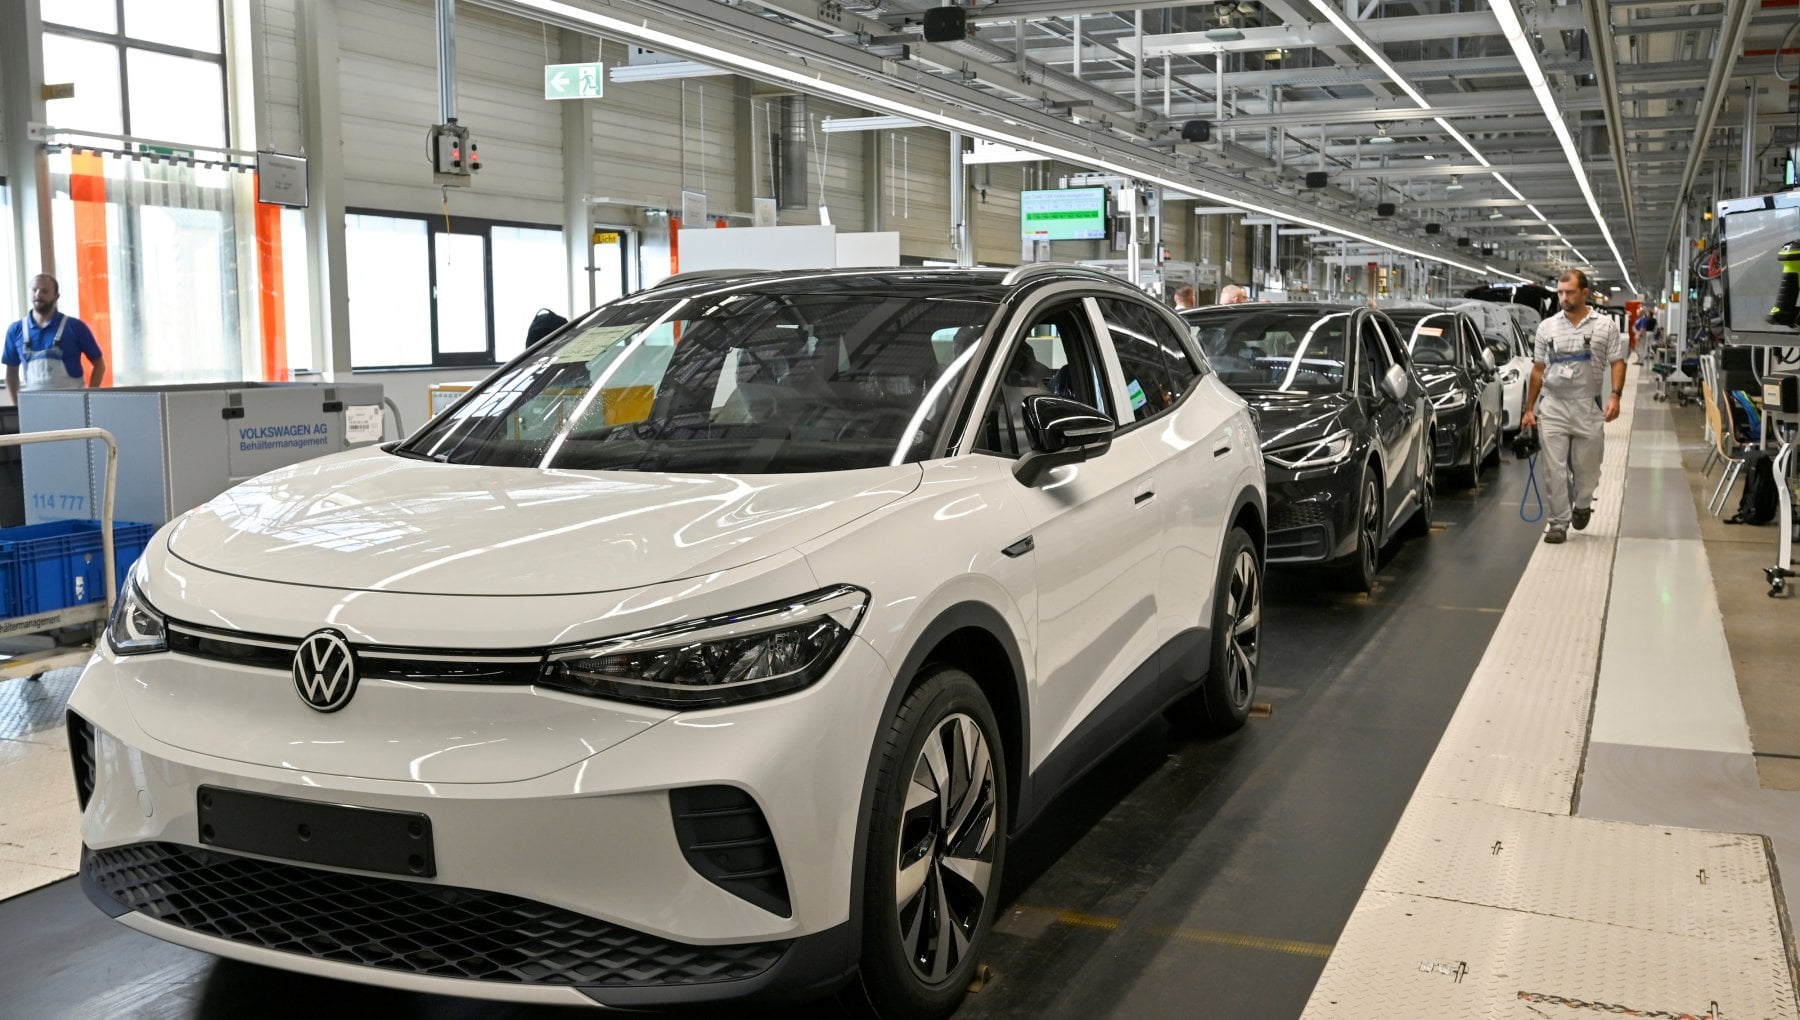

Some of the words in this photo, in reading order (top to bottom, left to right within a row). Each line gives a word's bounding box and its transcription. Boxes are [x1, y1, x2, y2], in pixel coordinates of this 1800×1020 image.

[598, 233, 616, 244] Licht
[240, 424, 311, 440] VOLKSWAGEN
[313, 423, 327, 434] AG
[240, 437, 328, 451] Behältermanagement
[32, 494, 55, 509] 114
[60, 495, 84, 511] 777
[293, 632, 354, 709] VW
